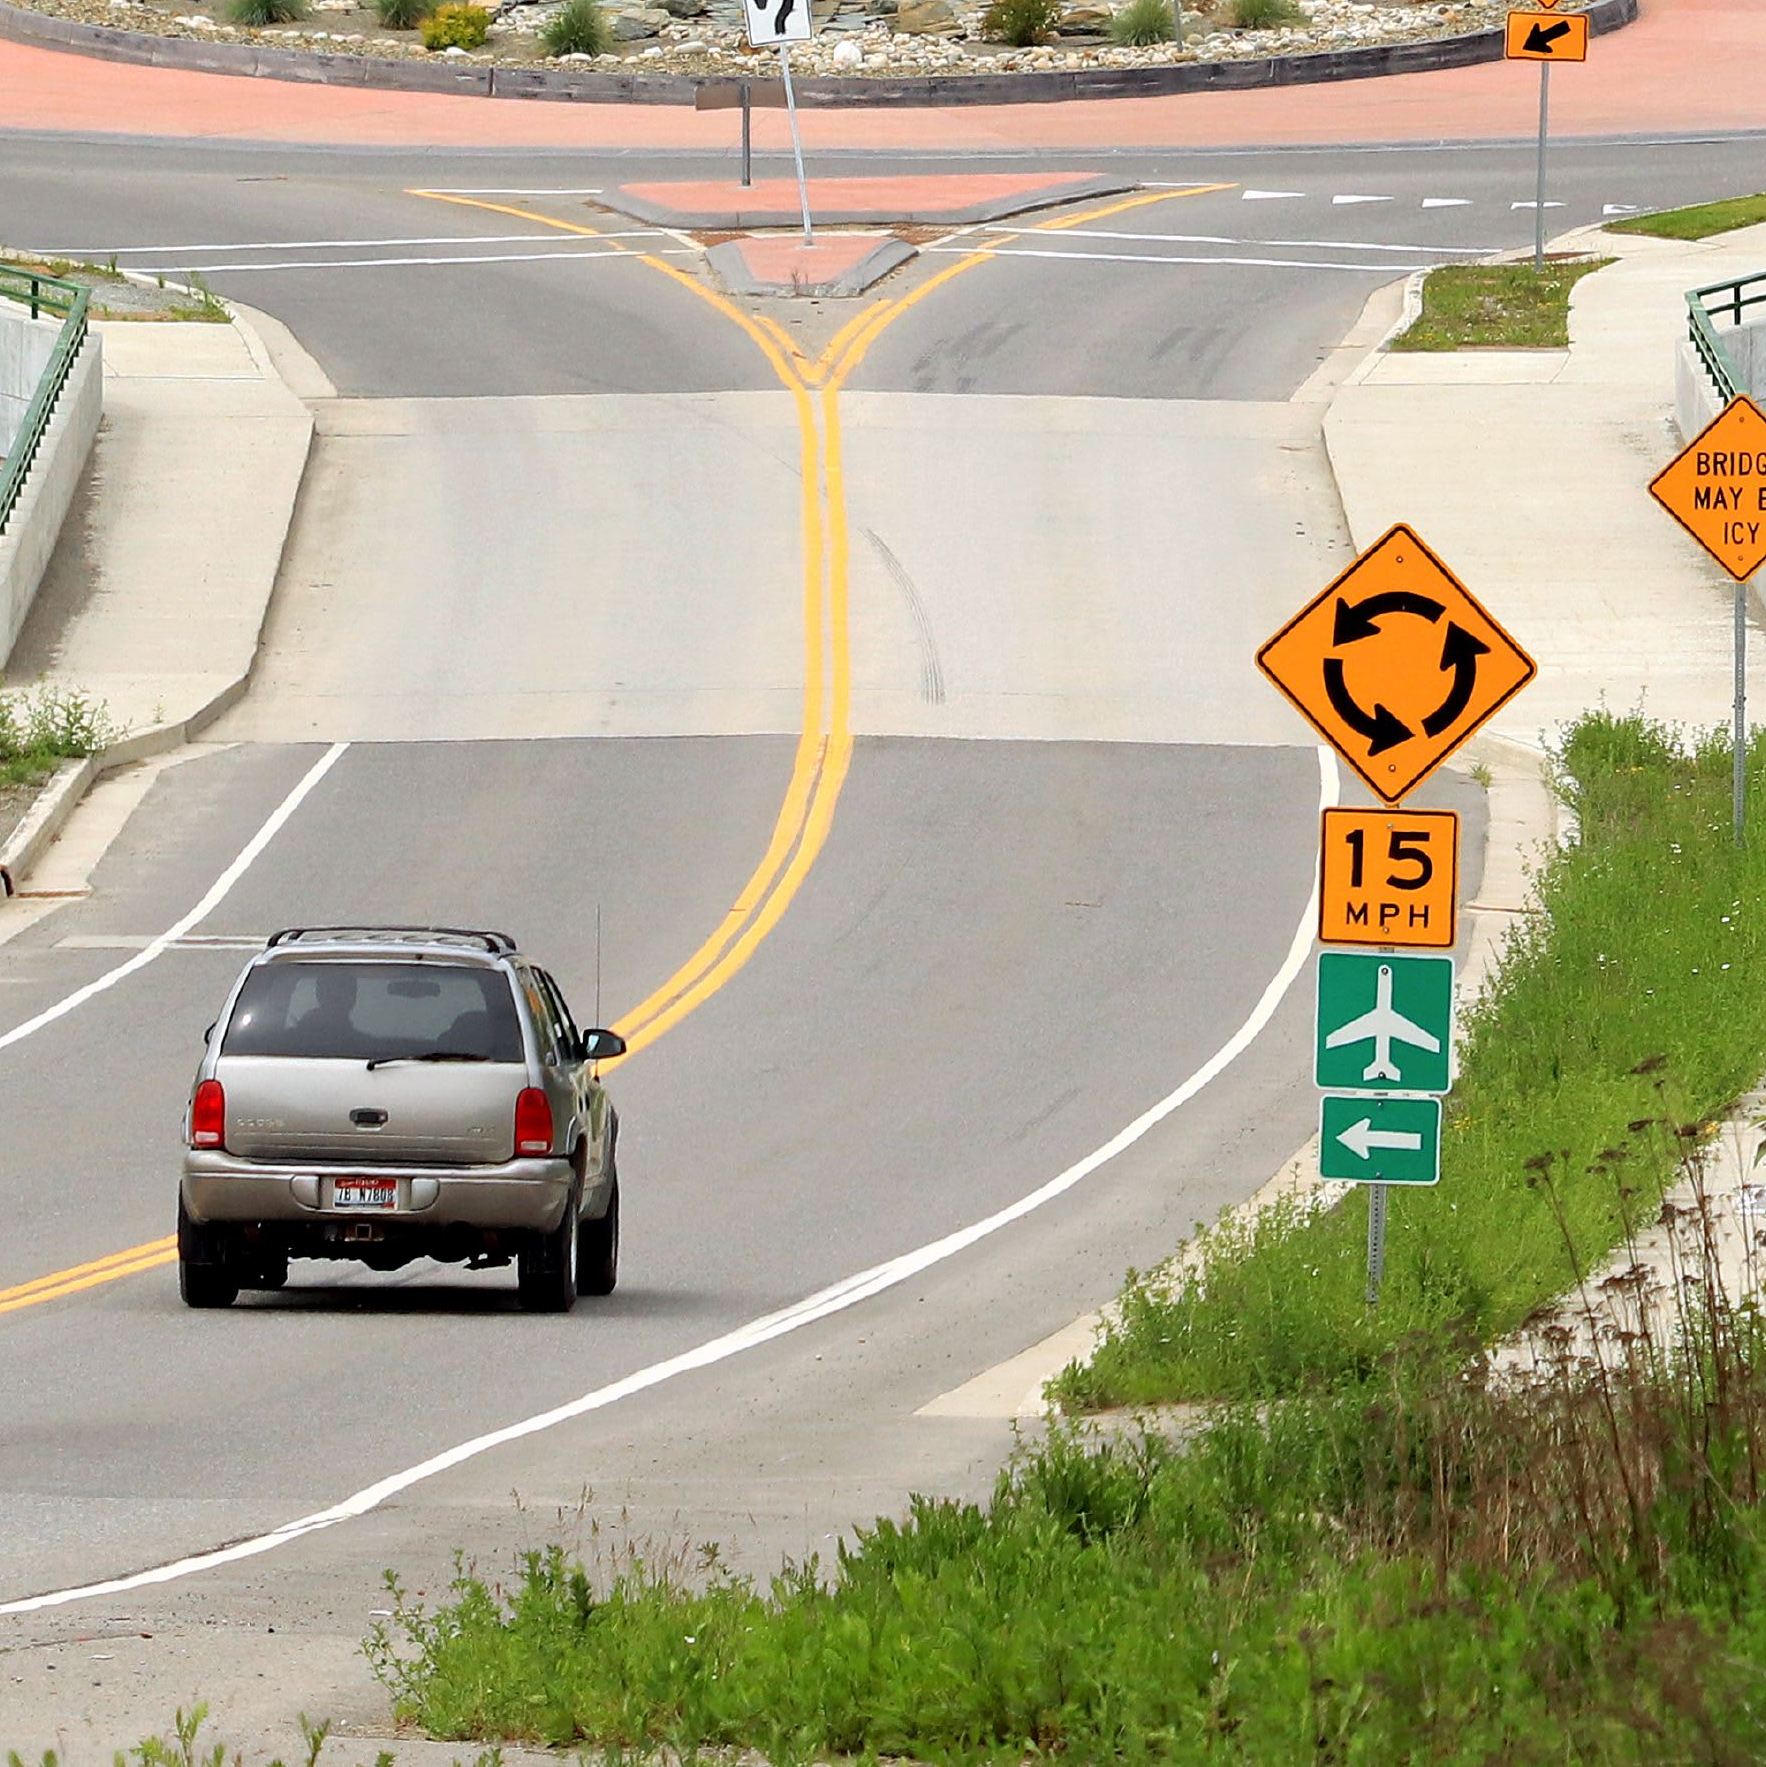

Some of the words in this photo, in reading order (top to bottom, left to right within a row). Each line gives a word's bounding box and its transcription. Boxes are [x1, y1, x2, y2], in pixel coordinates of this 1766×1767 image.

[1694, 486, 1744, 511] MAY
[1723, 521, 1761, 545] ICY
[1345, 829, 1433, 891] 15
[1346, 901, 1430, 929] MPH
